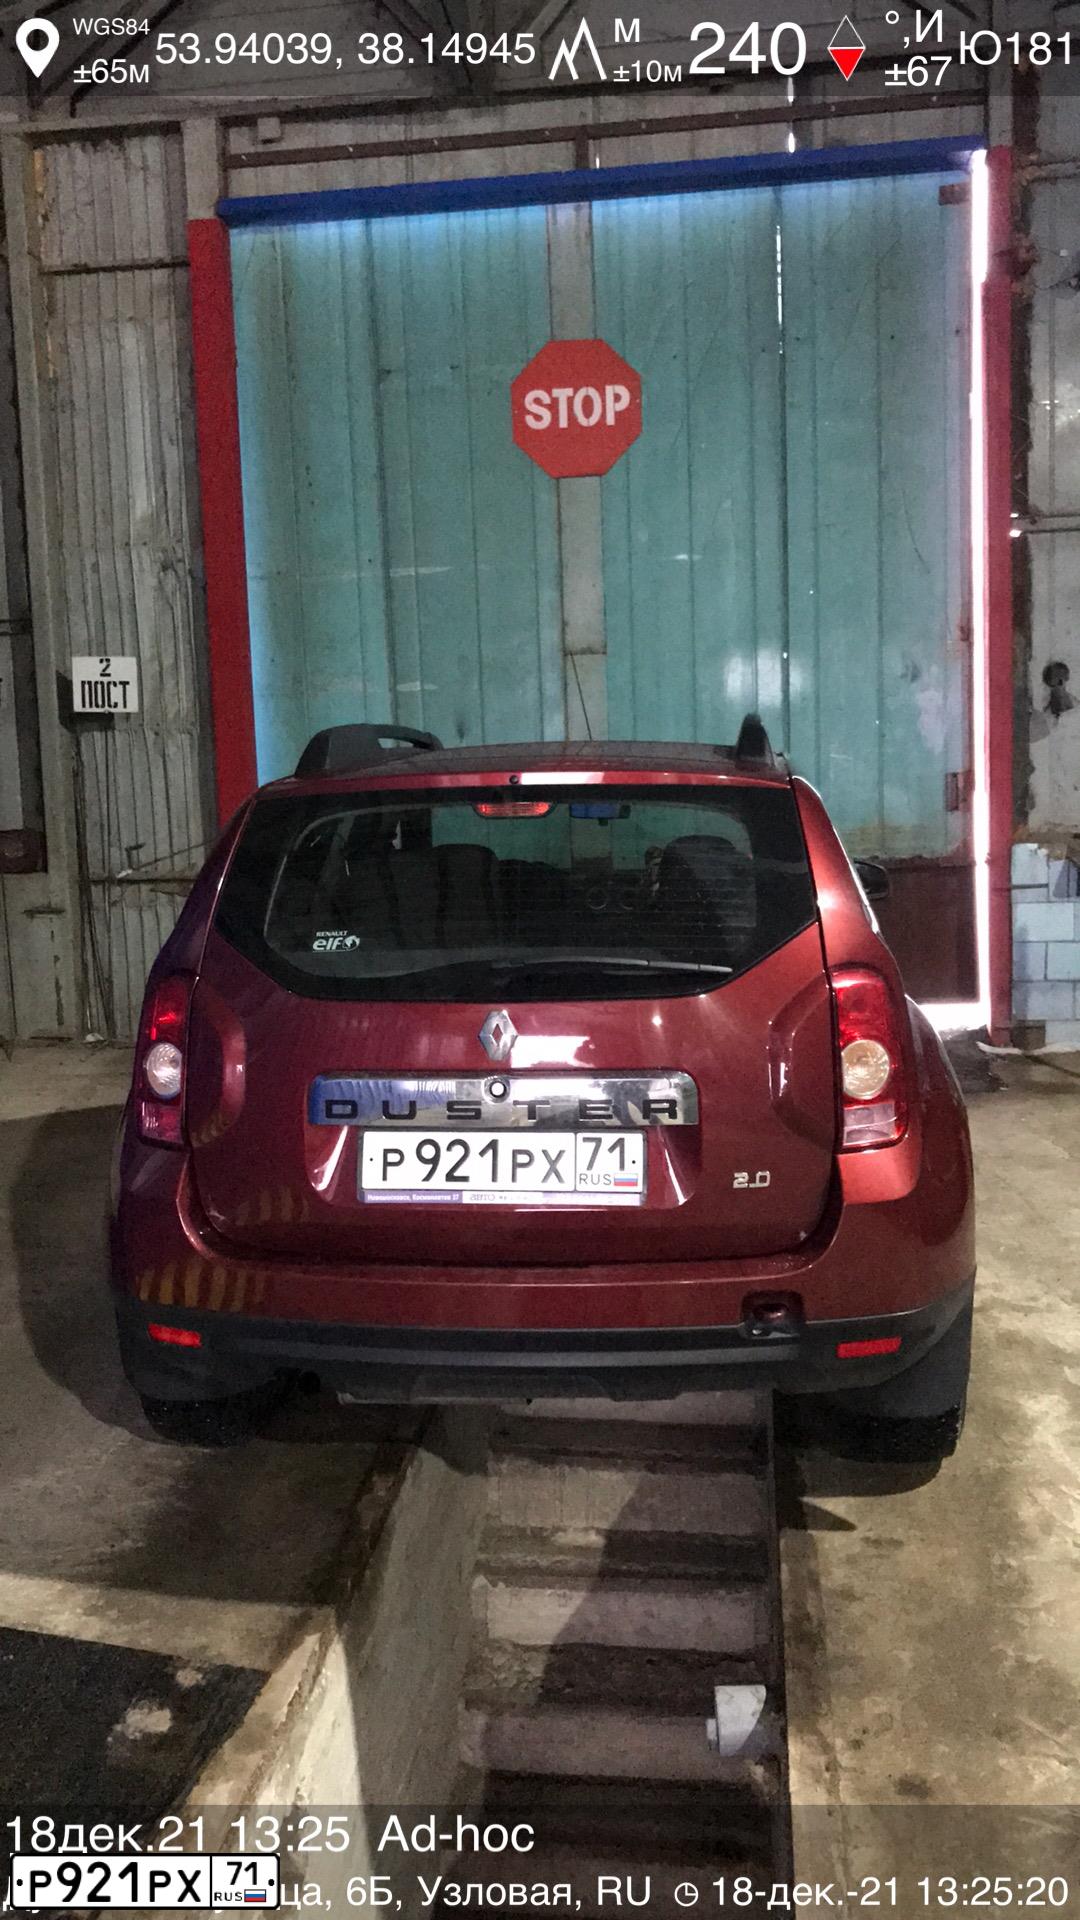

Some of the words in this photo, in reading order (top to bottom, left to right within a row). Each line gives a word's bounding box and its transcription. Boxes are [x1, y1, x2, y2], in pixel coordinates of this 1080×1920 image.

[524, 384, 631, 430] STOP
[99, 657, 111, 678] 2
[81, 680, 130, 709] ПОСТ
[312, 936, 344, 951] elf
[324, 1098, 679, 1122] DUSTER
[582, 1136, 626, 1172] 71
[578, 1172, 612, 1186] RUS
[732, 1170, 771, 1189] 2.0
